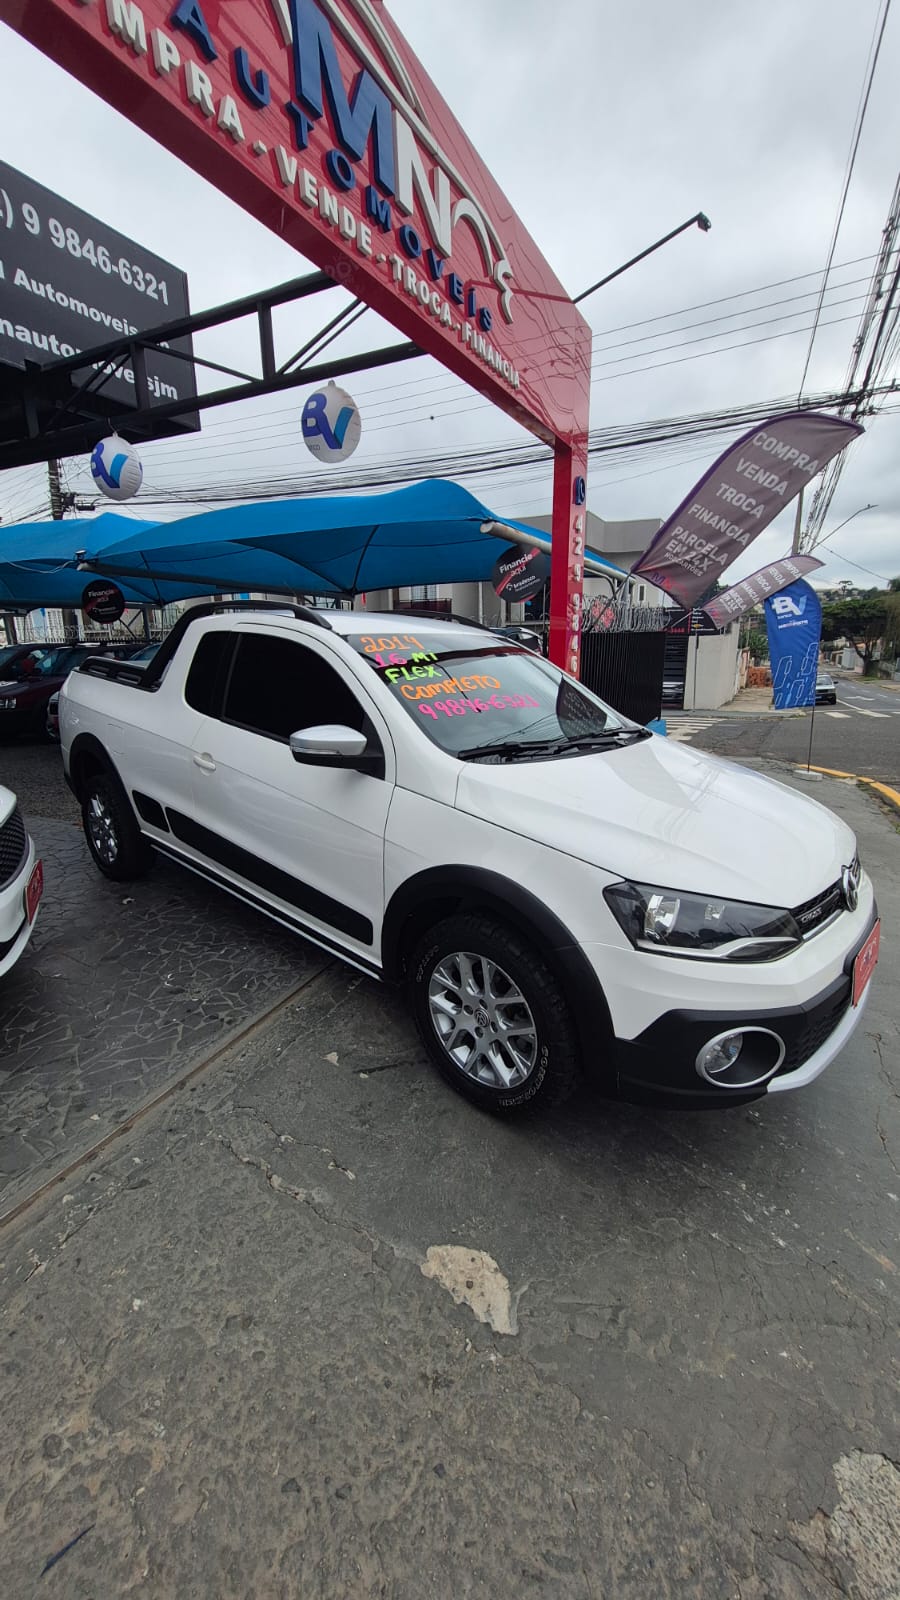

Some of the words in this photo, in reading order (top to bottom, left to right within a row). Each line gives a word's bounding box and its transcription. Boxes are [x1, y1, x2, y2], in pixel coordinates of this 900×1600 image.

[80, 0, 245, 143] MPRA
[274, 144, 373, 256] VENDE
[390, 253, 453, 327] TROCA
[461, 321, 521, 389] FINANCIA
[21, 202, 40, 235] 9
[48, 217, 170, 306] 9846-6321
[13, 267, 139, 336] Automoveis
[752, 431, 820, 476] COMPRA
[735, 457, 789, 497] VENDA
[714, 482, 767, 520] TROCA
[687, 503, 752, 547] FINANCIA
[499, 553, 534, 574] Financie
[670, 526, 729, 566] PARCELA
[360, 635, 425, 653] 2014
[384, 665, 442, 684] FLEX
[400, 675, 501, 701] COMPLETO
